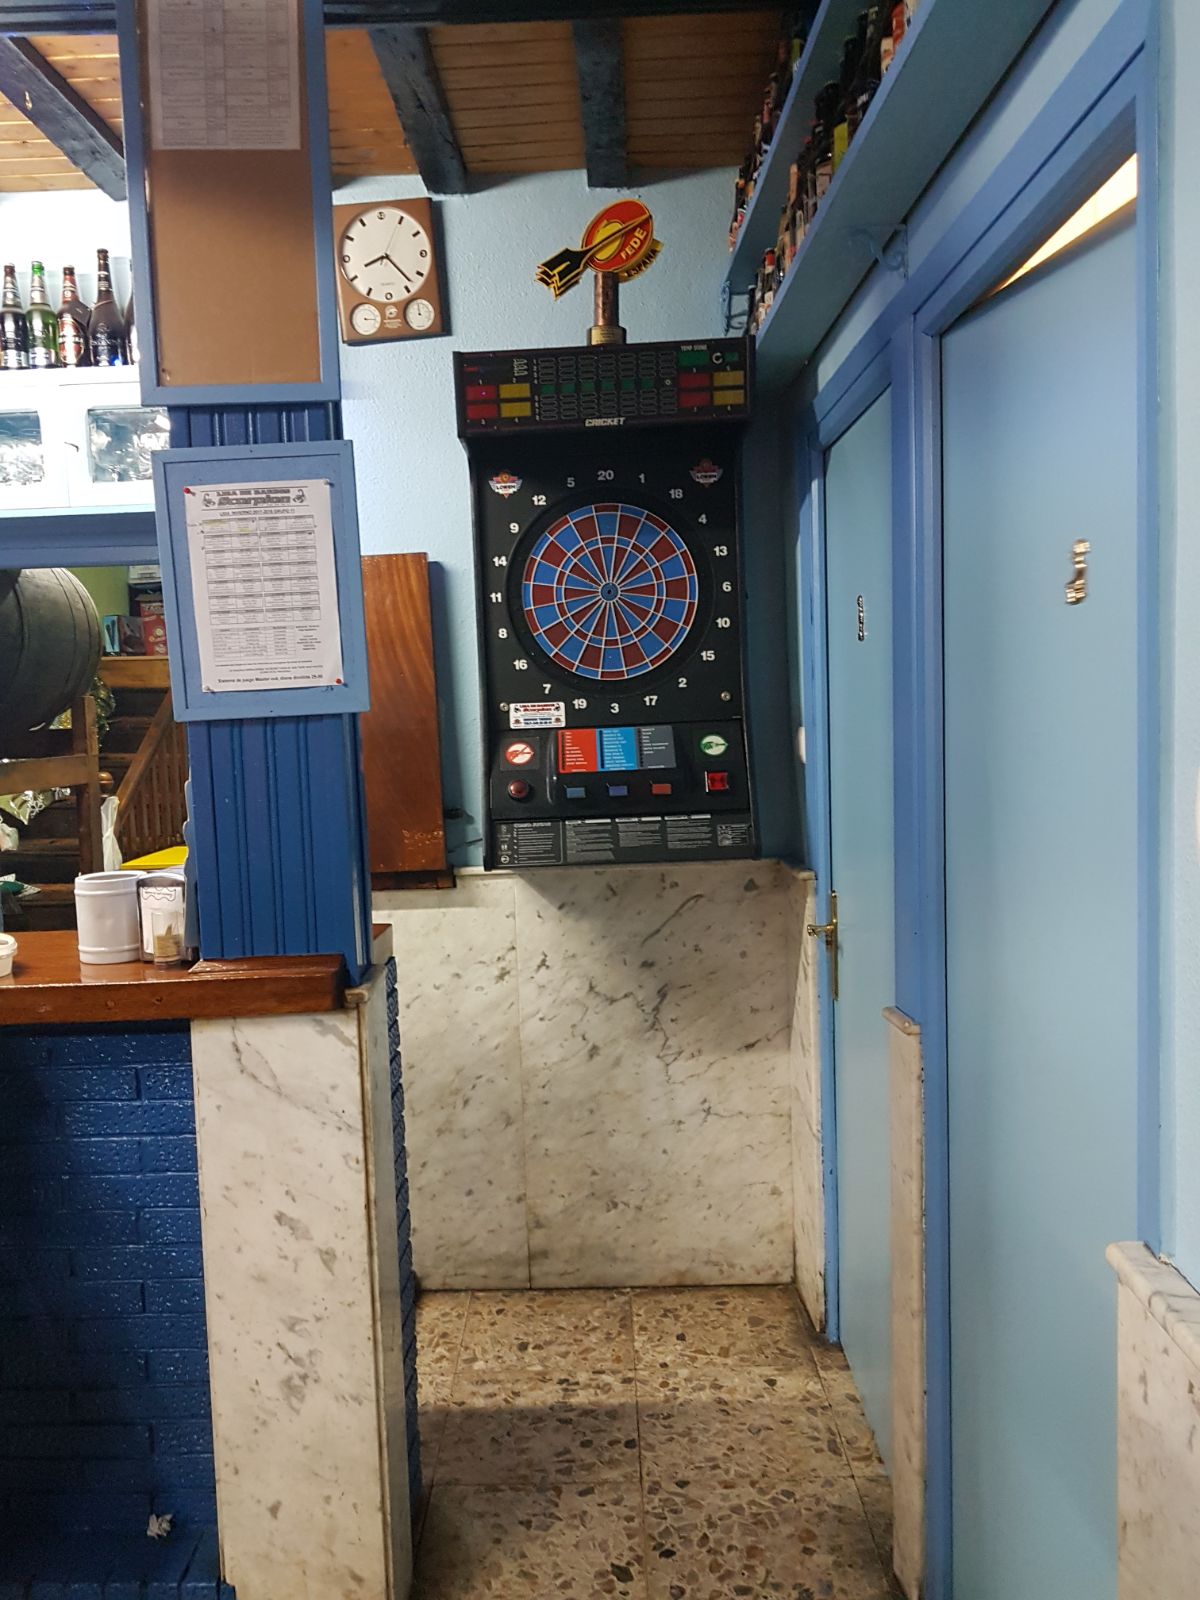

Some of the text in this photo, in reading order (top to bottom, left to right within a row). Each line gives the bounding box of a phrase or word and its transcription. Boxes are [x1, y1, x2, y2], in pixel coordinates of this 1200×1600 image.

[620, 227, 647, 260] FEDE
[584, 417, 626, 427] CRICKET
[597, 470, 614, 481] 20
[638, 473, 646, 483] 1
[567, 477, 576, 488] 5
[669, 489, 684, 499] 18
[531, 495, 546, 505] 12
[698, 514, 707, 524] 4
[509, 523, 519, 533] 9
[714, 545, 728, 556] 13
[492, 556, 507, 567] 14
[722, 582, 732, 592] 6
[490, 592, 502, 603] 11
[716, 617, 731, 628] 10
[498, 628, 508, 639] 8
[701, 650, 716, 661] 15
[513, 659, 528, 670] 16
[678, 677, 687, 688] 2
[542, 683, 552, 694] 7
[572, 698, 587, 709] 19
[643, 695, 658, 706] 17
[610, 702, 620, 713] 3
